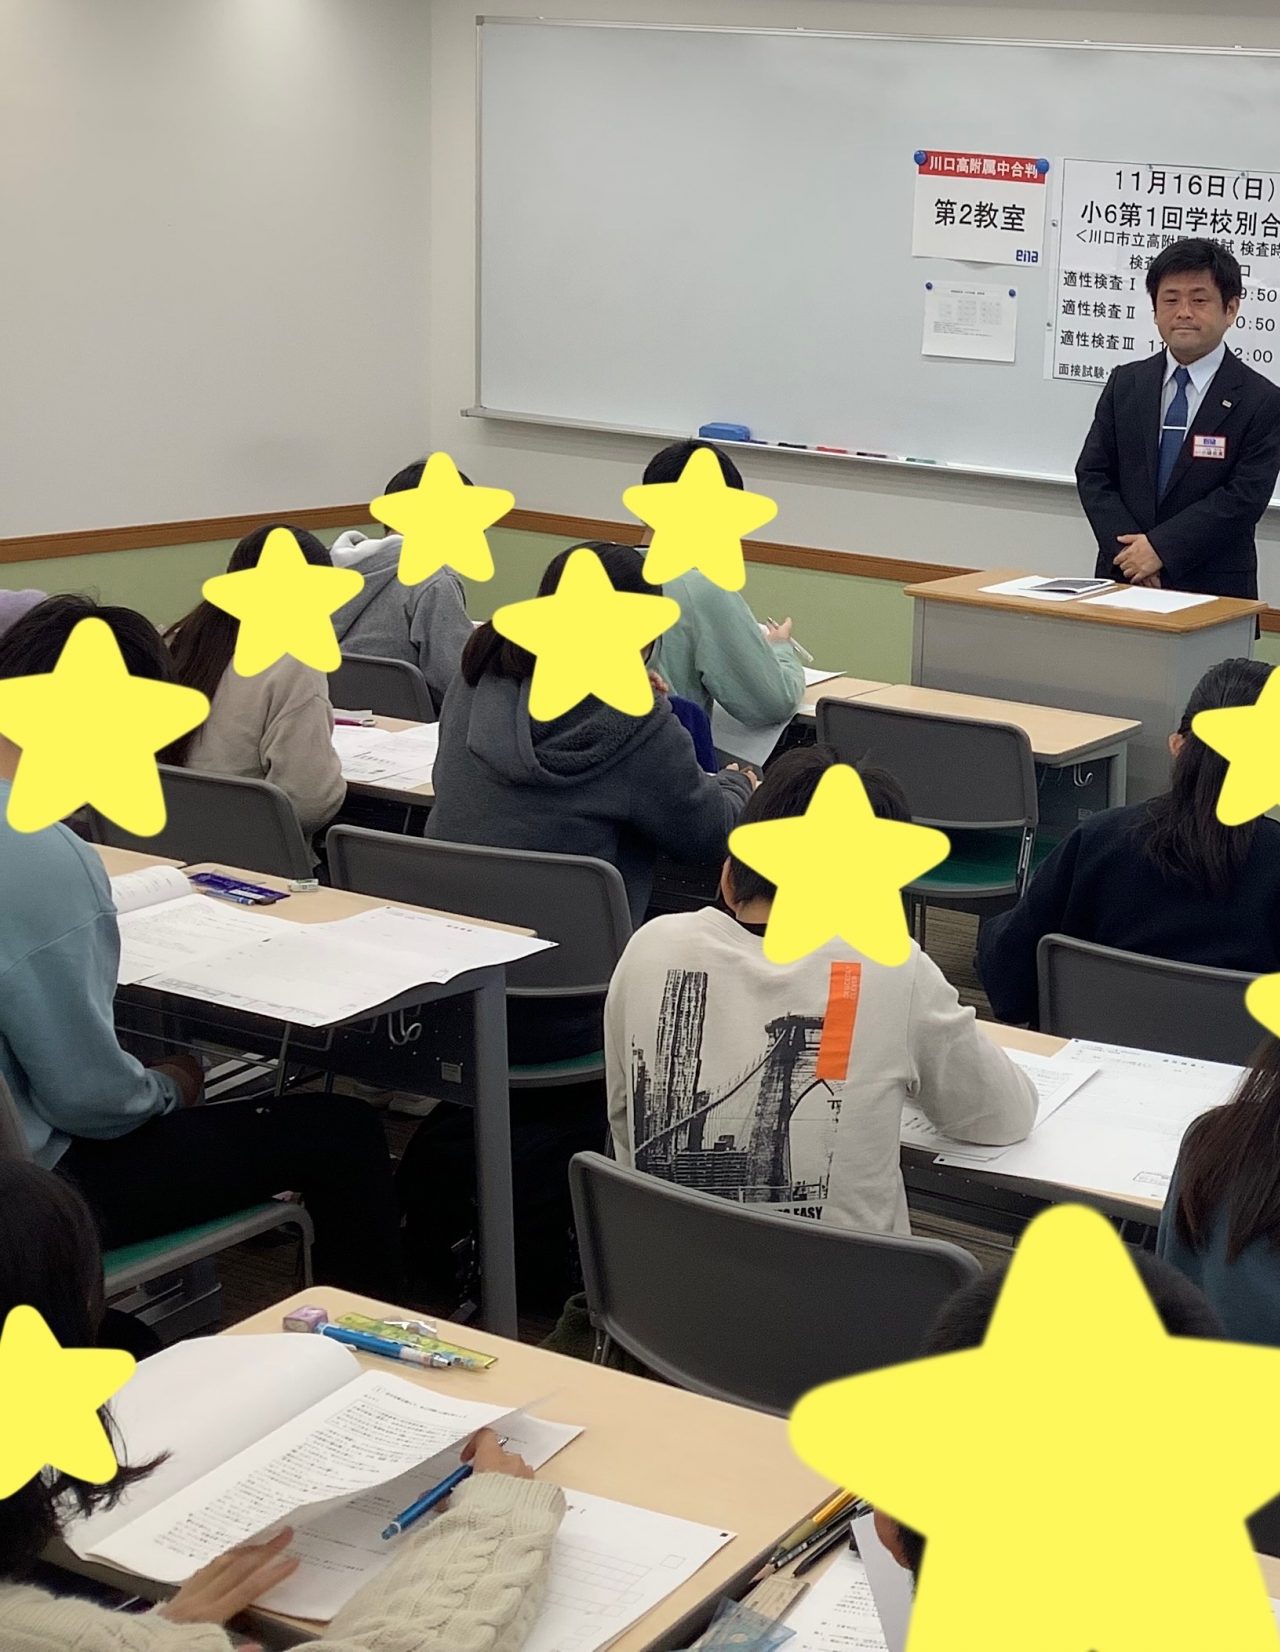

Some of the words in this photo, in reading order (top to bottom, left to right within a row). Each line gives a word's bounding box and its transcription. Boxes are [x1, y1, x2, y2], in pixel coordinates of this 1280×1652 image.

[1115, 169, 1275, 202] 11月16日(日)
[934, 198, 1025, 232] 第2教室
[1015, 249, 1039, 263] ena
[1058, 362, 1114, 379] 面接試験・
